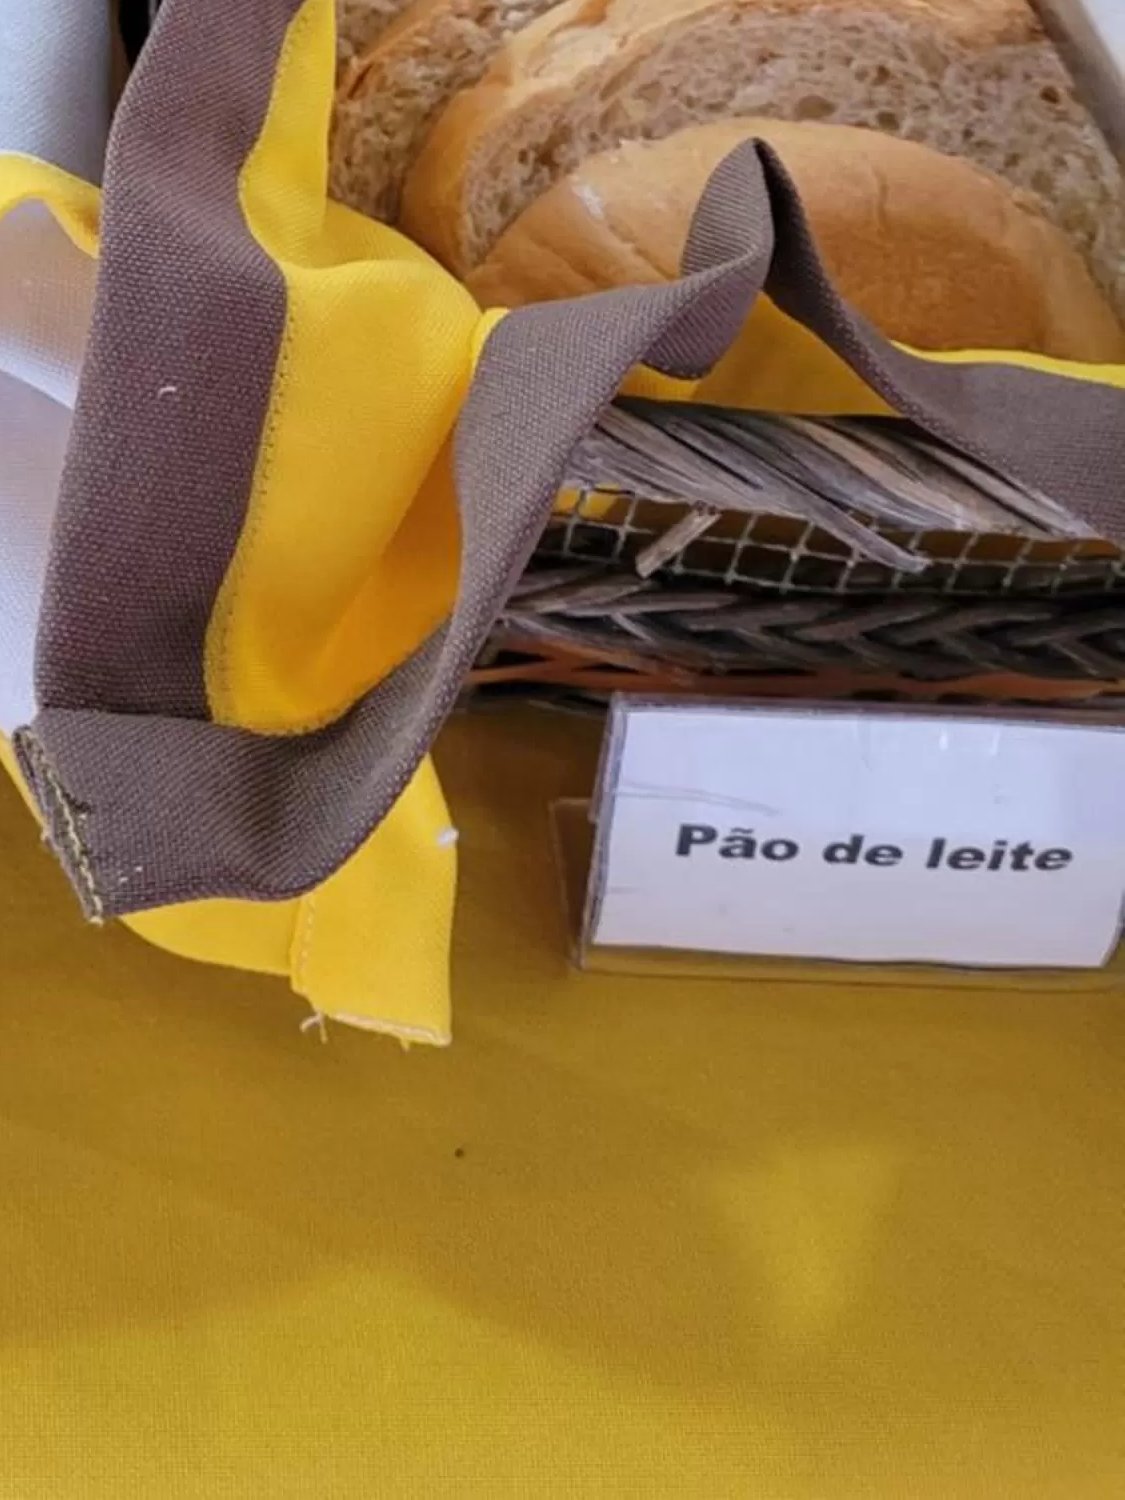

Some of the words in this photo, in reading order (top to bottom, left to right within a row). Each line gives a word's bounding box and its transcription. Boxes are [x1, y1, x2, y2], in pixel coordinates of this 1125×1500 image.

[675, 822, 800, 862] Pão
[823, 834, 903, 867] de
[926, 837, 1073, 871] leite
